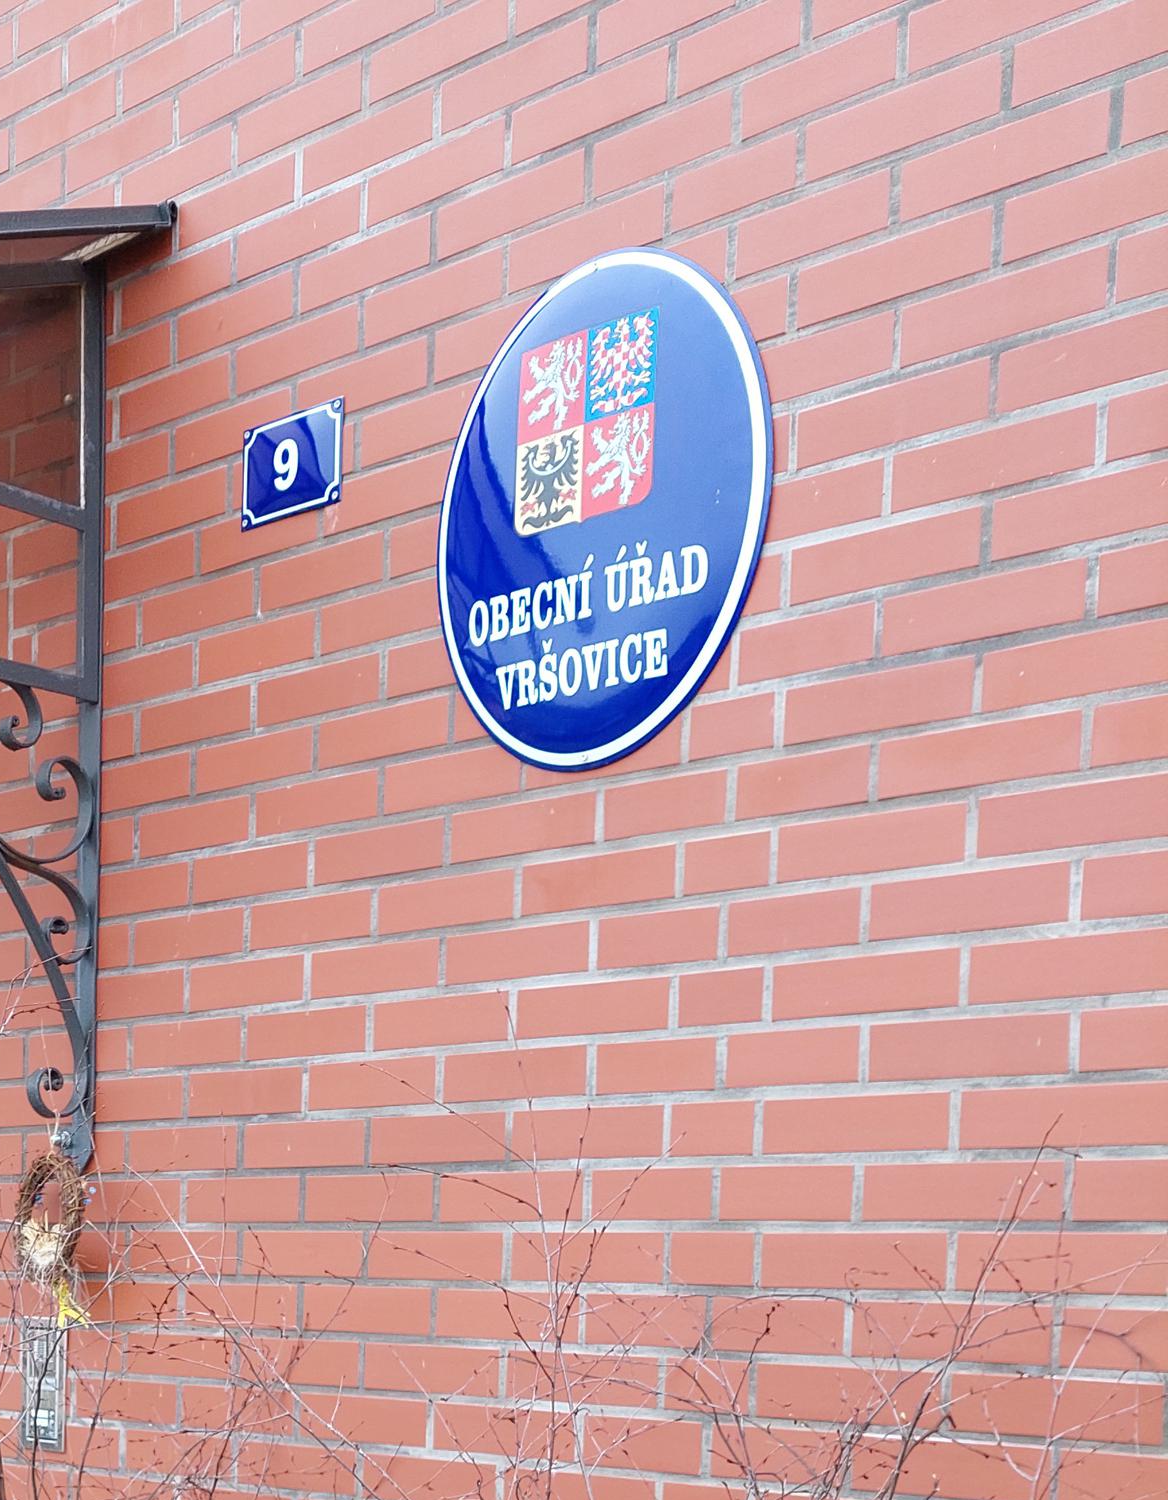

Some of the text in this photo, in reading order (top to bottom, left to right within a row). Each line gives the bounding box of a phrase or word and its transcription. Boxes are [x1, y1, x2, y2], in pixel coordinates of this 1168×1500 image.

[273, 438, 299, 491] 9
[468, 539, 710, 648] OBECNÍ ÚŘAD
[495, 628, 669, 712] VRŠOVICE
